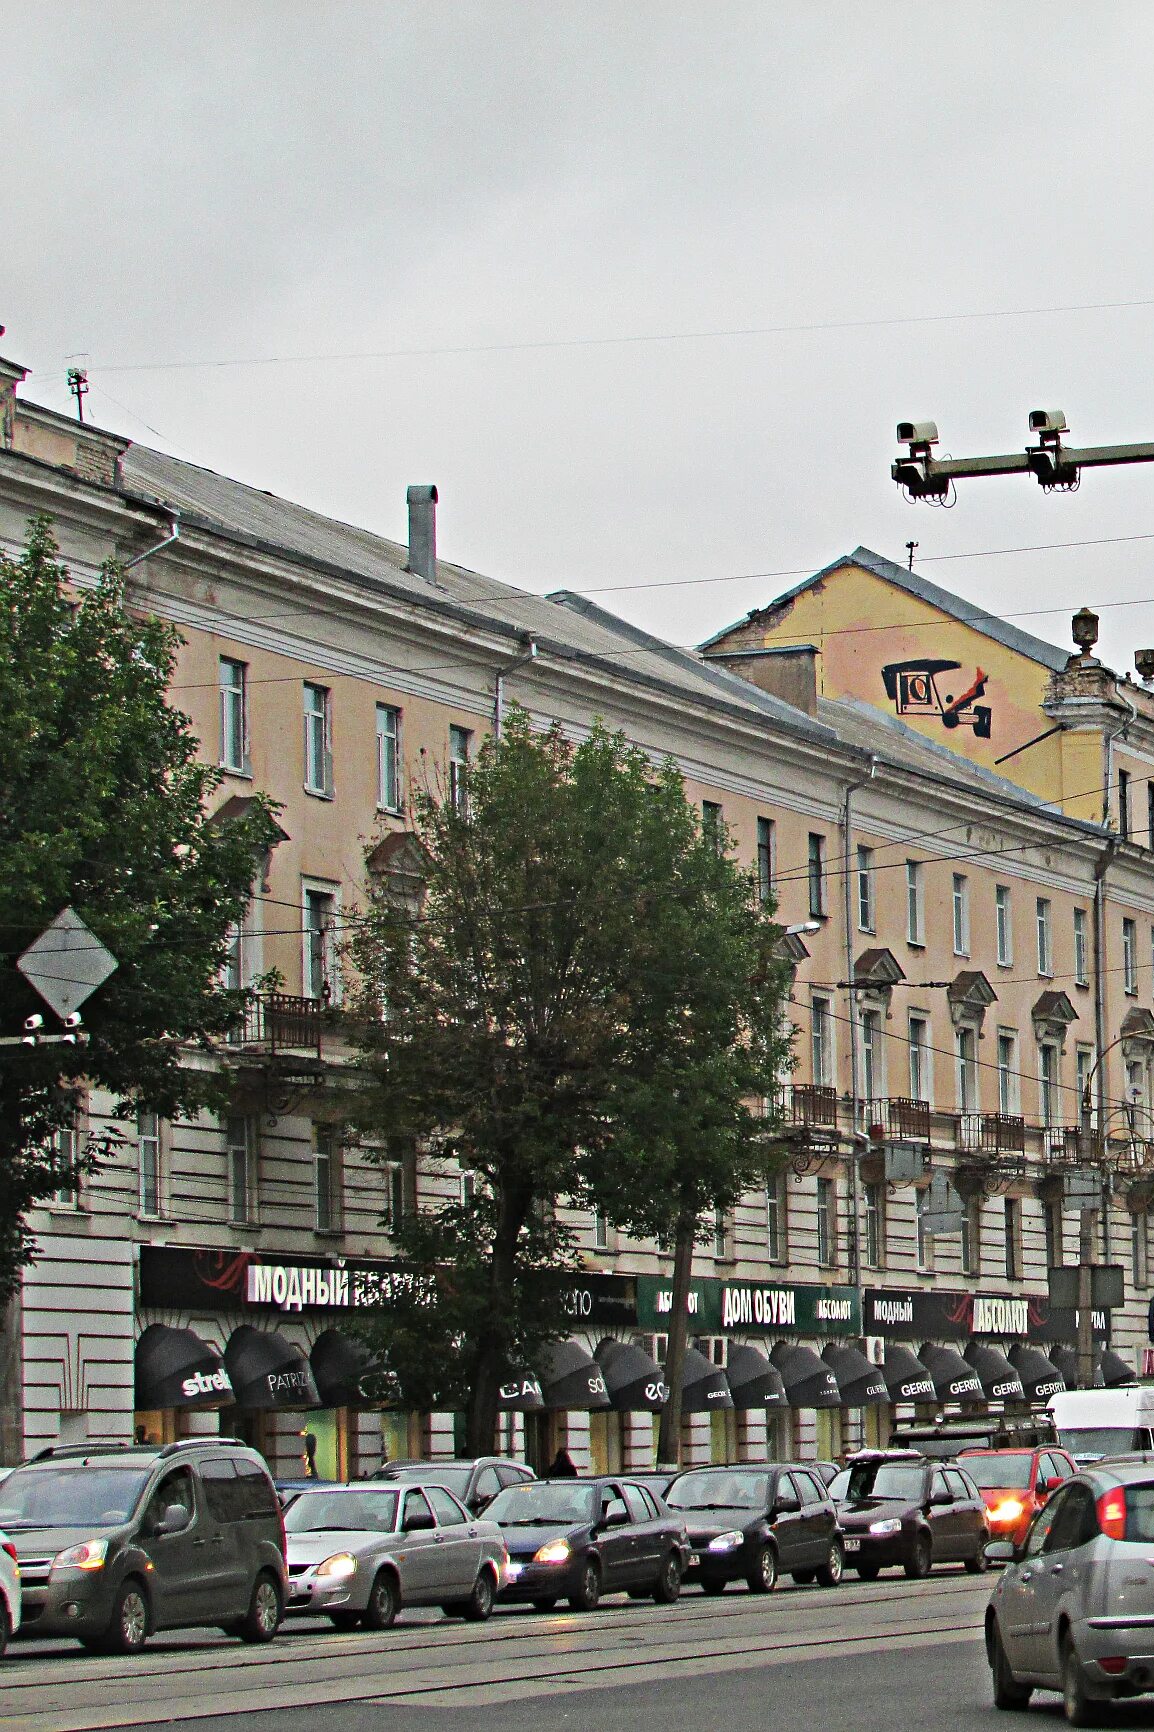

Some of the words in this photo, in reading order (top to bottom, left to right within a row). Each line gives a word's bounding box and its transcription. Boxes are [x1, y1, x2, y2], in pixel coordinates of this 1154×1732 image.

[251, 1260, 349, 1311] МОДНЫЙ
[723, 1287, 752, 1327] ДОМ
[753, 1289, 796, 1325] ОБУВИ
[817, 1299, 852, 1320] АБСОЛЮТ
[874, 1296, 913, 1325] МОДНЫЙ
[975, 1299, 1029, 1334] АБСОЛЮТ
